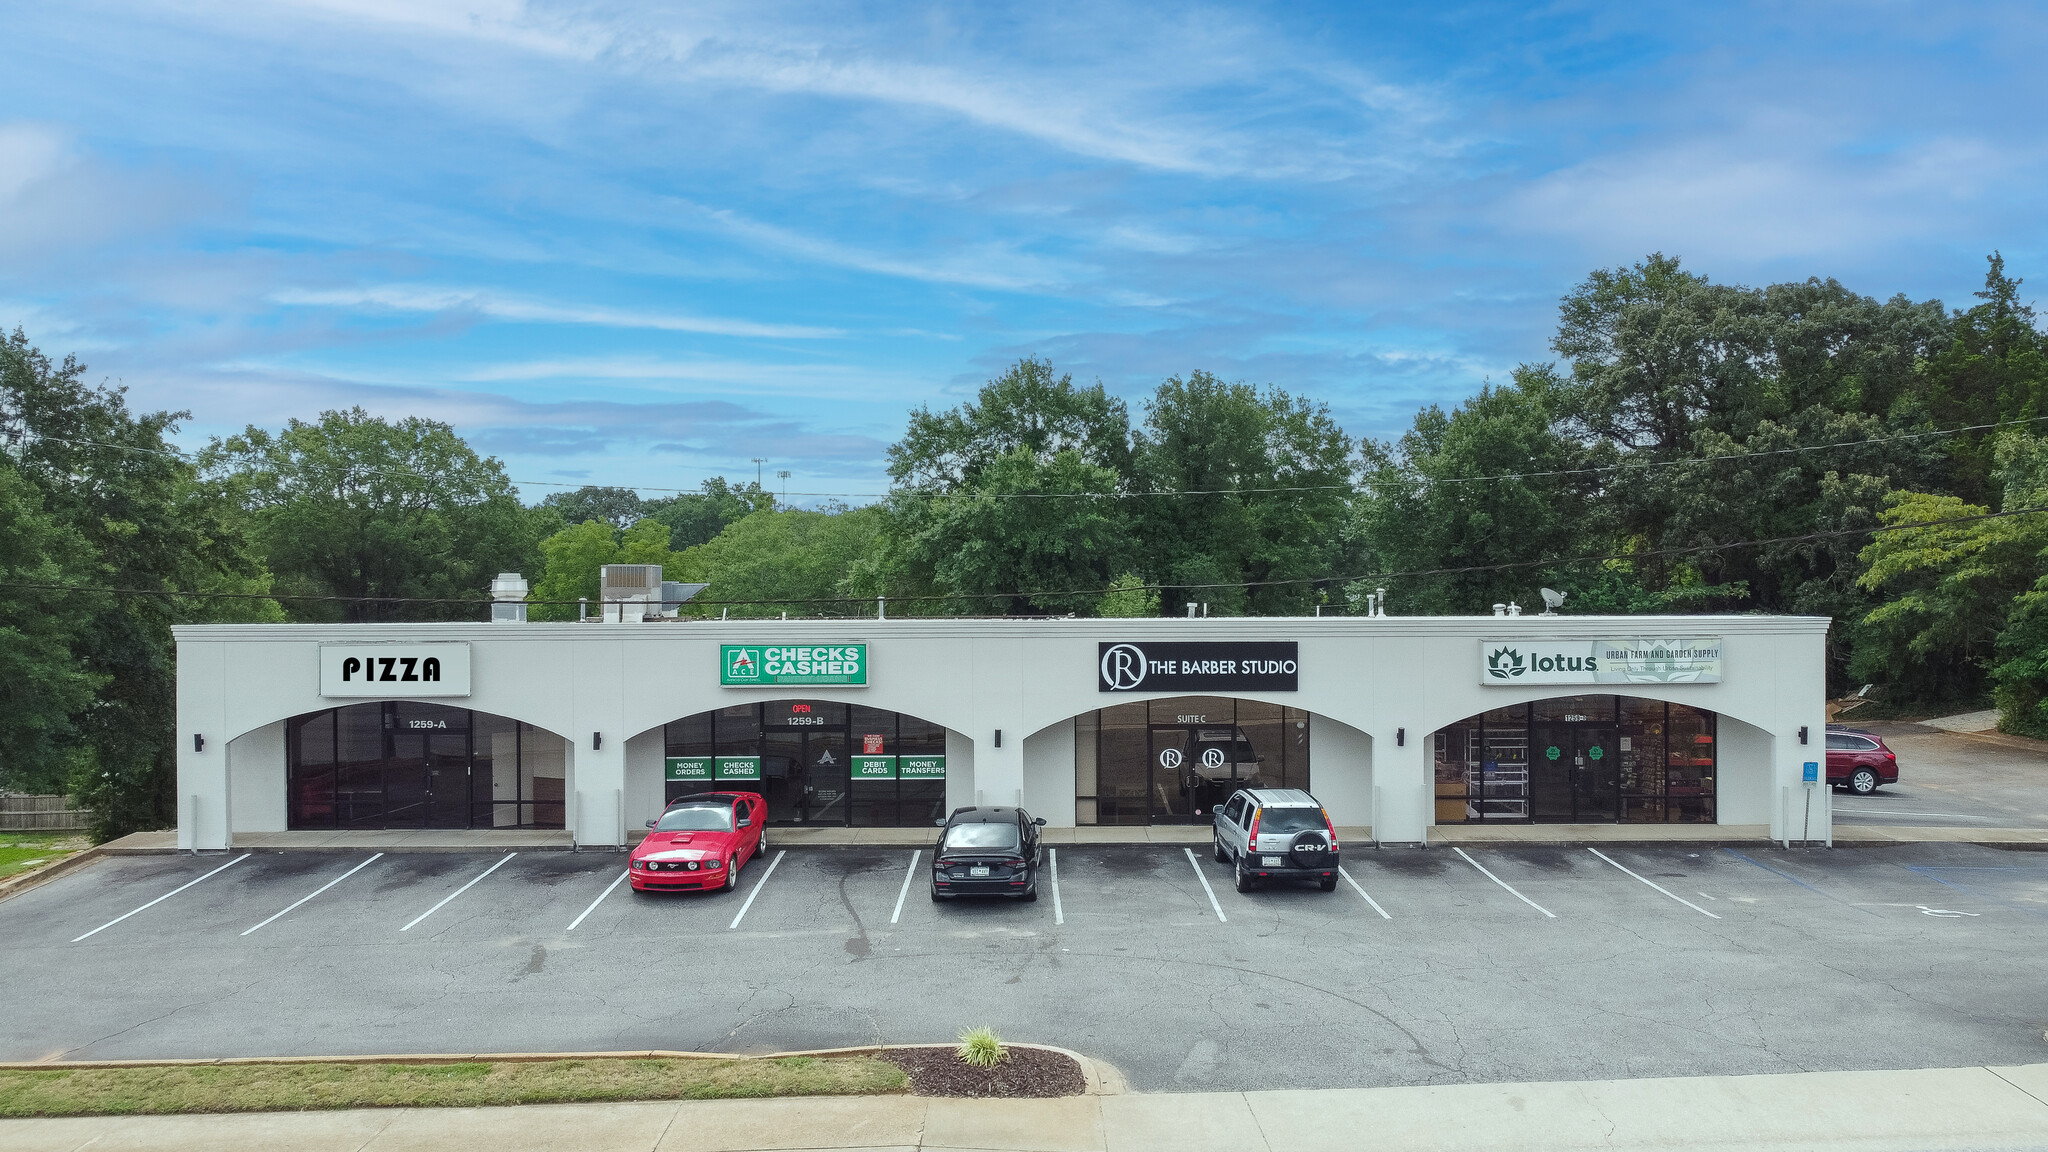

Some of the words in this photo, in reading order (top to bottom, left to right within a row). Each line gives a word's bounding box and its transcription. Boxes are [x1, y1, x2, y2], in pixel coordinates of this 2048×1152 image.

[764, 647, 859, 661] CHECKS
[1606, 650, 1628, 659] URBAN
[1631, 650, 1648, 659] FARM
[1650, 650, 1664, 659] AND
[1666, 649, 1692, 658] GARDEN
[1694, 649, 1719, 658] SUPPLY
[343, 657, 440, 681] PIZZA
[764, 661, 859, 675] CASHED
[1149, 660, 1176, 674] THE
[1182, 660, 1236, 674] BARBER
[1241, 660, 1297, 674] STUDIO
[792, 704, 811, 713] OPEN
[787, 716, 824, 725] 1259-B
[1177, 714, 1199, 723] SUITE
[1200, 714, 1206, 723] C
[409, 720, 446, 729] 1259-A
